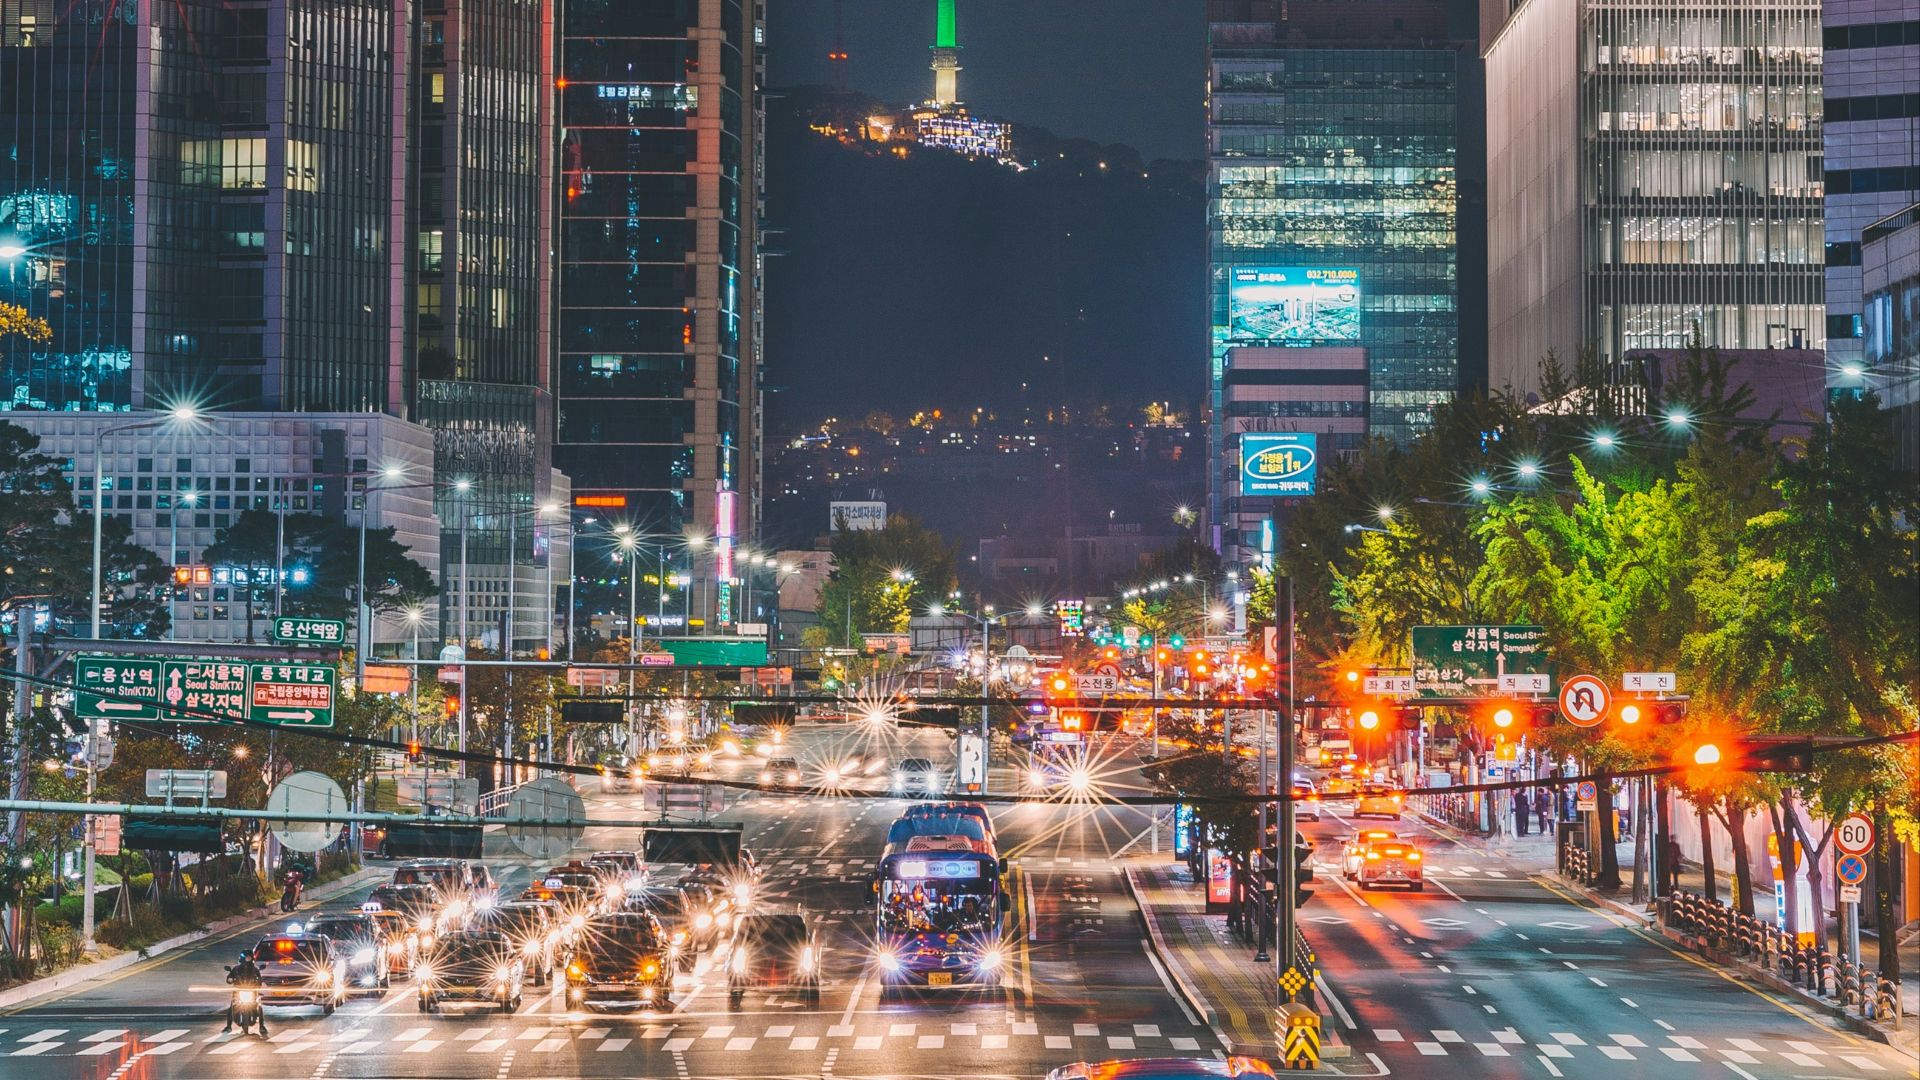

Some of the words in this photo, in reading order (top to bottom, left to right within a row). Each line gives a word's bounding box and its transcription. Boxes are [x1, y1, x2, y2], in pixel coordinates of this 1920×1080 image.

[280, 621, 339, 639] 용산역앞
[1465, 628, 1500, 640] 서울역
[1503, 631, 1527, 639] Seoul
[1452, 640, 1500, 652] 삼각지역
[102, 667, 153, 685] 용산역
[201, 664, 245, 681] 서울역
[260, 666, 325, 682] 동작대교
[1416, 669, 1464, 681] 전자상가
[185, 679, 208, 690] Seoul
[209, 680, 244, 691] Stn(KTX)
[1070, 678, 1114, 690] 버스전용
[1368, 680, 1411, 691] 좌회전
[1506, 678, 1541, 689] 직진
[1632, 676, 1667, 688] 직진
[118, 685, 156, 697] Stn(KTX)
[268, 685, 328, 699] 국립중앙박물관
[185, 692, 243, 709] 삼각지역
[1843, 825, 1866, 843] 60
